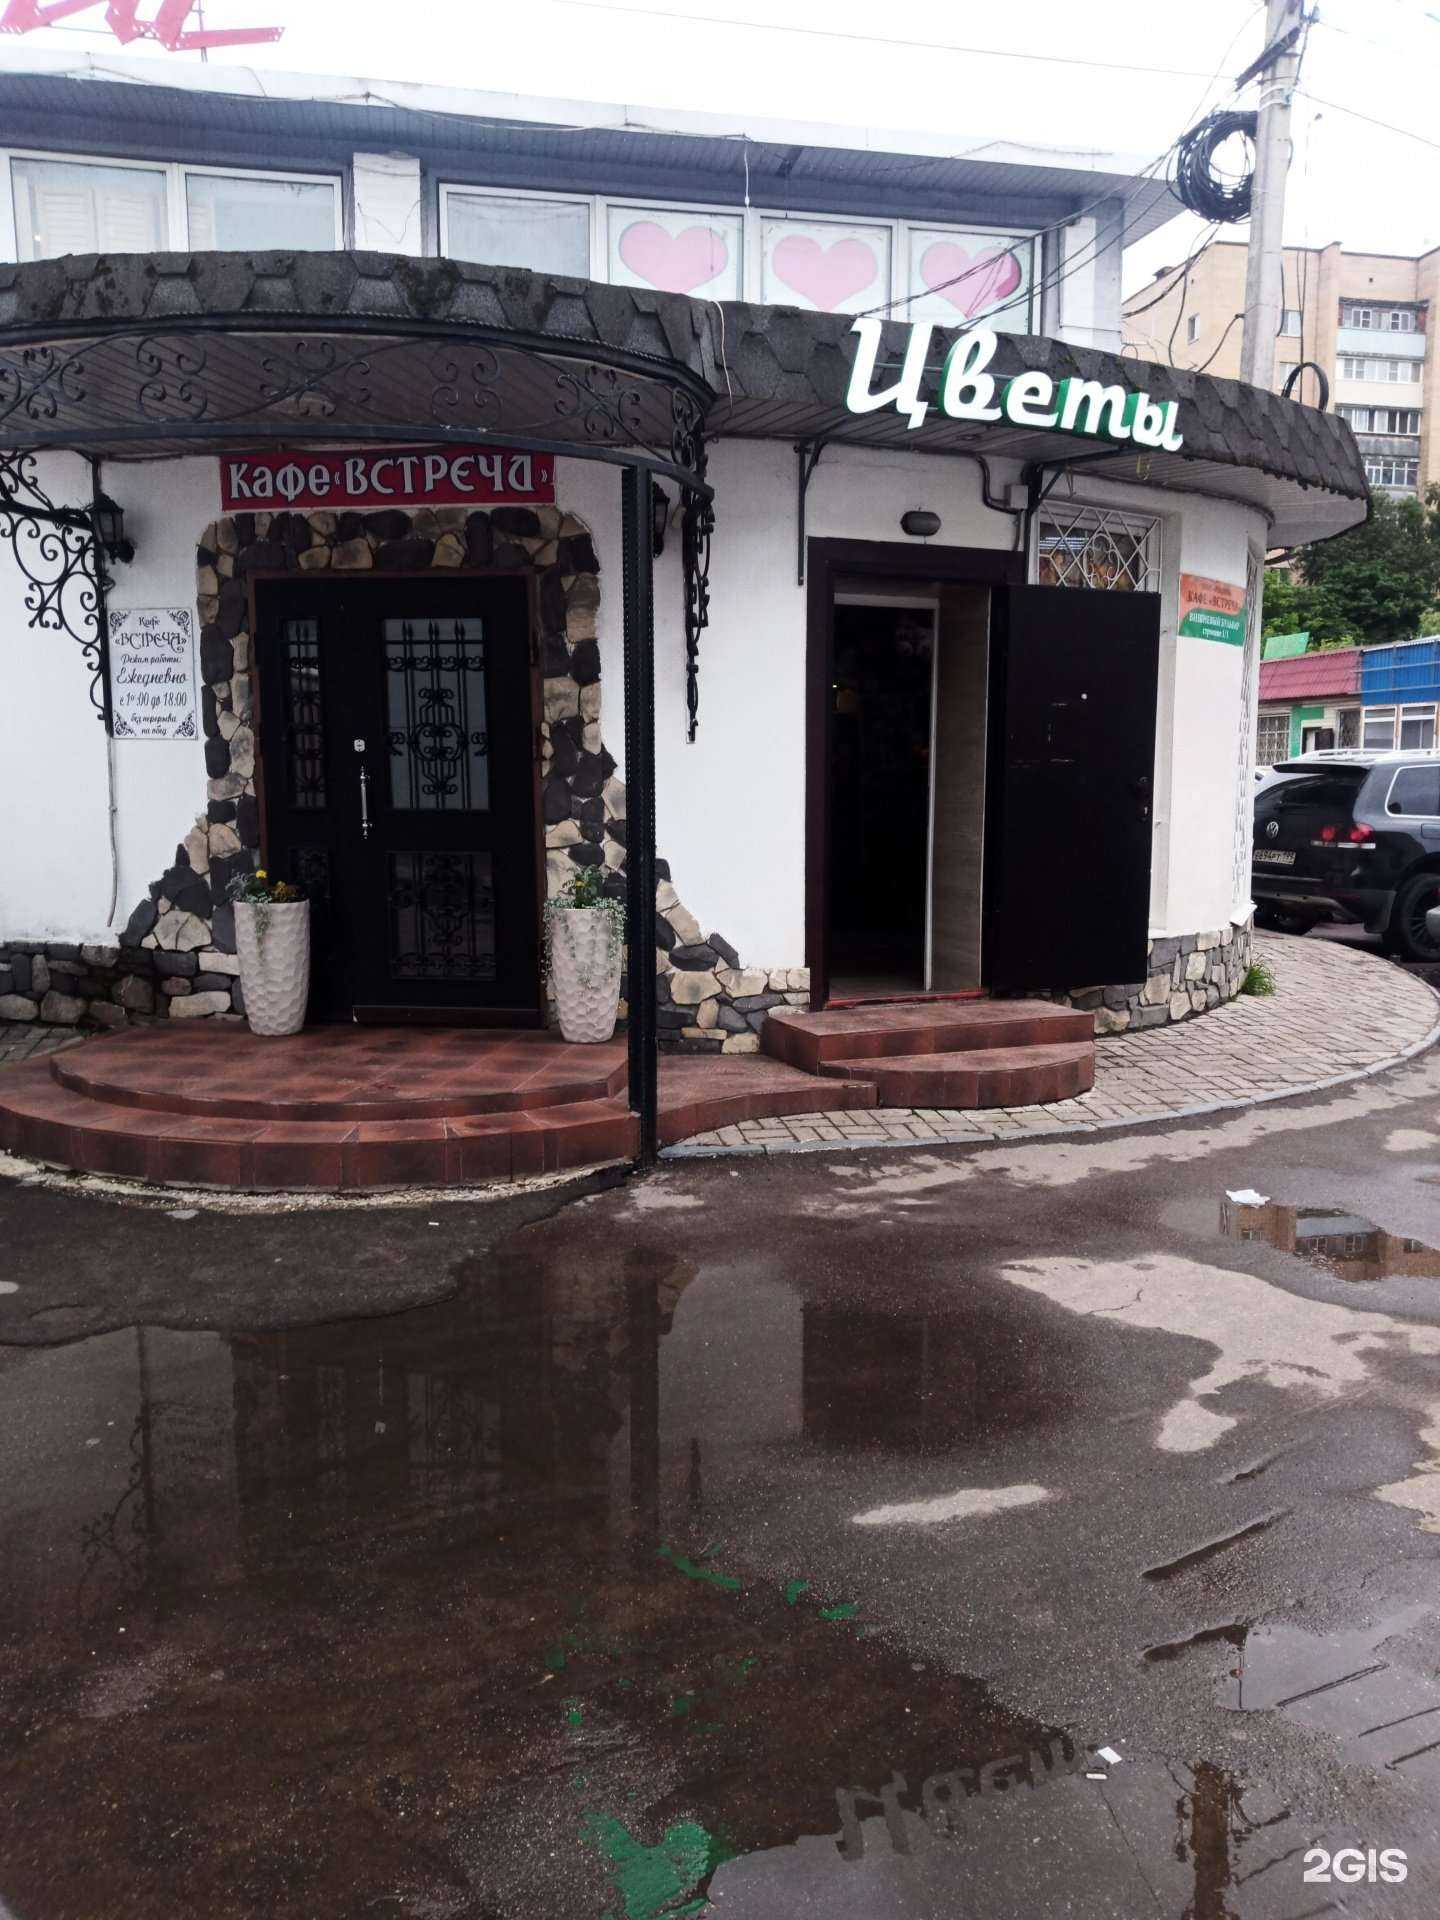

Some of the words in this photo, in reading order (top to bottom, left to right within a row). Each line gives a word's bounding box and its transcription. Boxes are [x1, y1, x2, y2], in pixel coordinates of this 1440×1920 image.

[845, 317, 1183, 451] Цветы
[229, 462, 330, 501] Кафе
[139, 616, 160, 630] Кафе
[117, 667, 187, 687] Ежедневно
[151, 696, 161, 710] до
